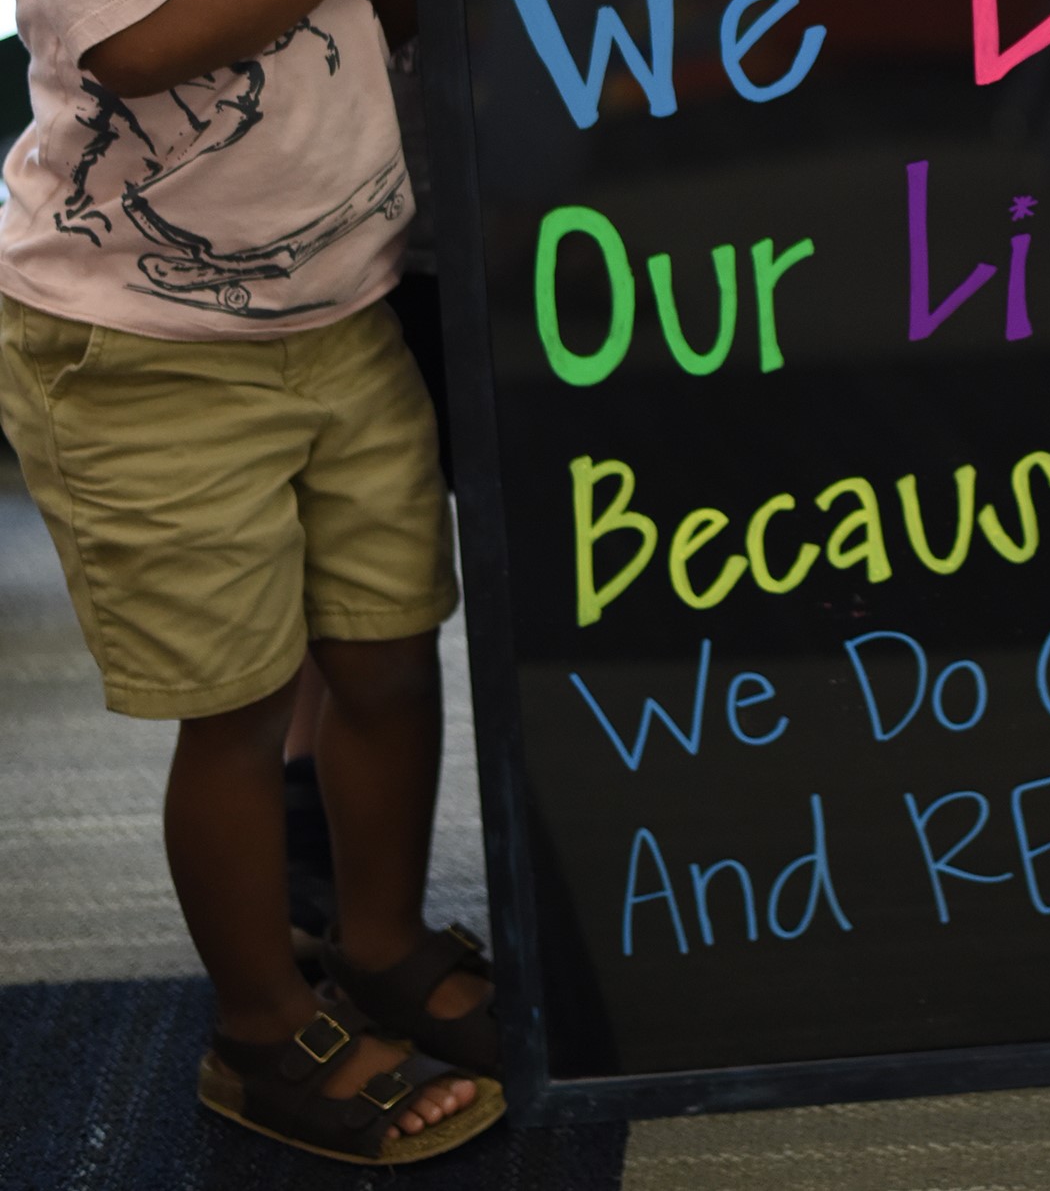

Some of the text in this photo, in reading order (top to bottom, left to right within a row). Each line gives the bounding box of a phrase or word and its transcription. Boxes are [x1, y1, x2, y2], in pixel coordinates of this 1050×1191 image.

[535, 206, 814, 385] Our
[571, 639, 788, 770] We
[845, 631, 987, 740] Do
[623, 793, 852, 955] And
